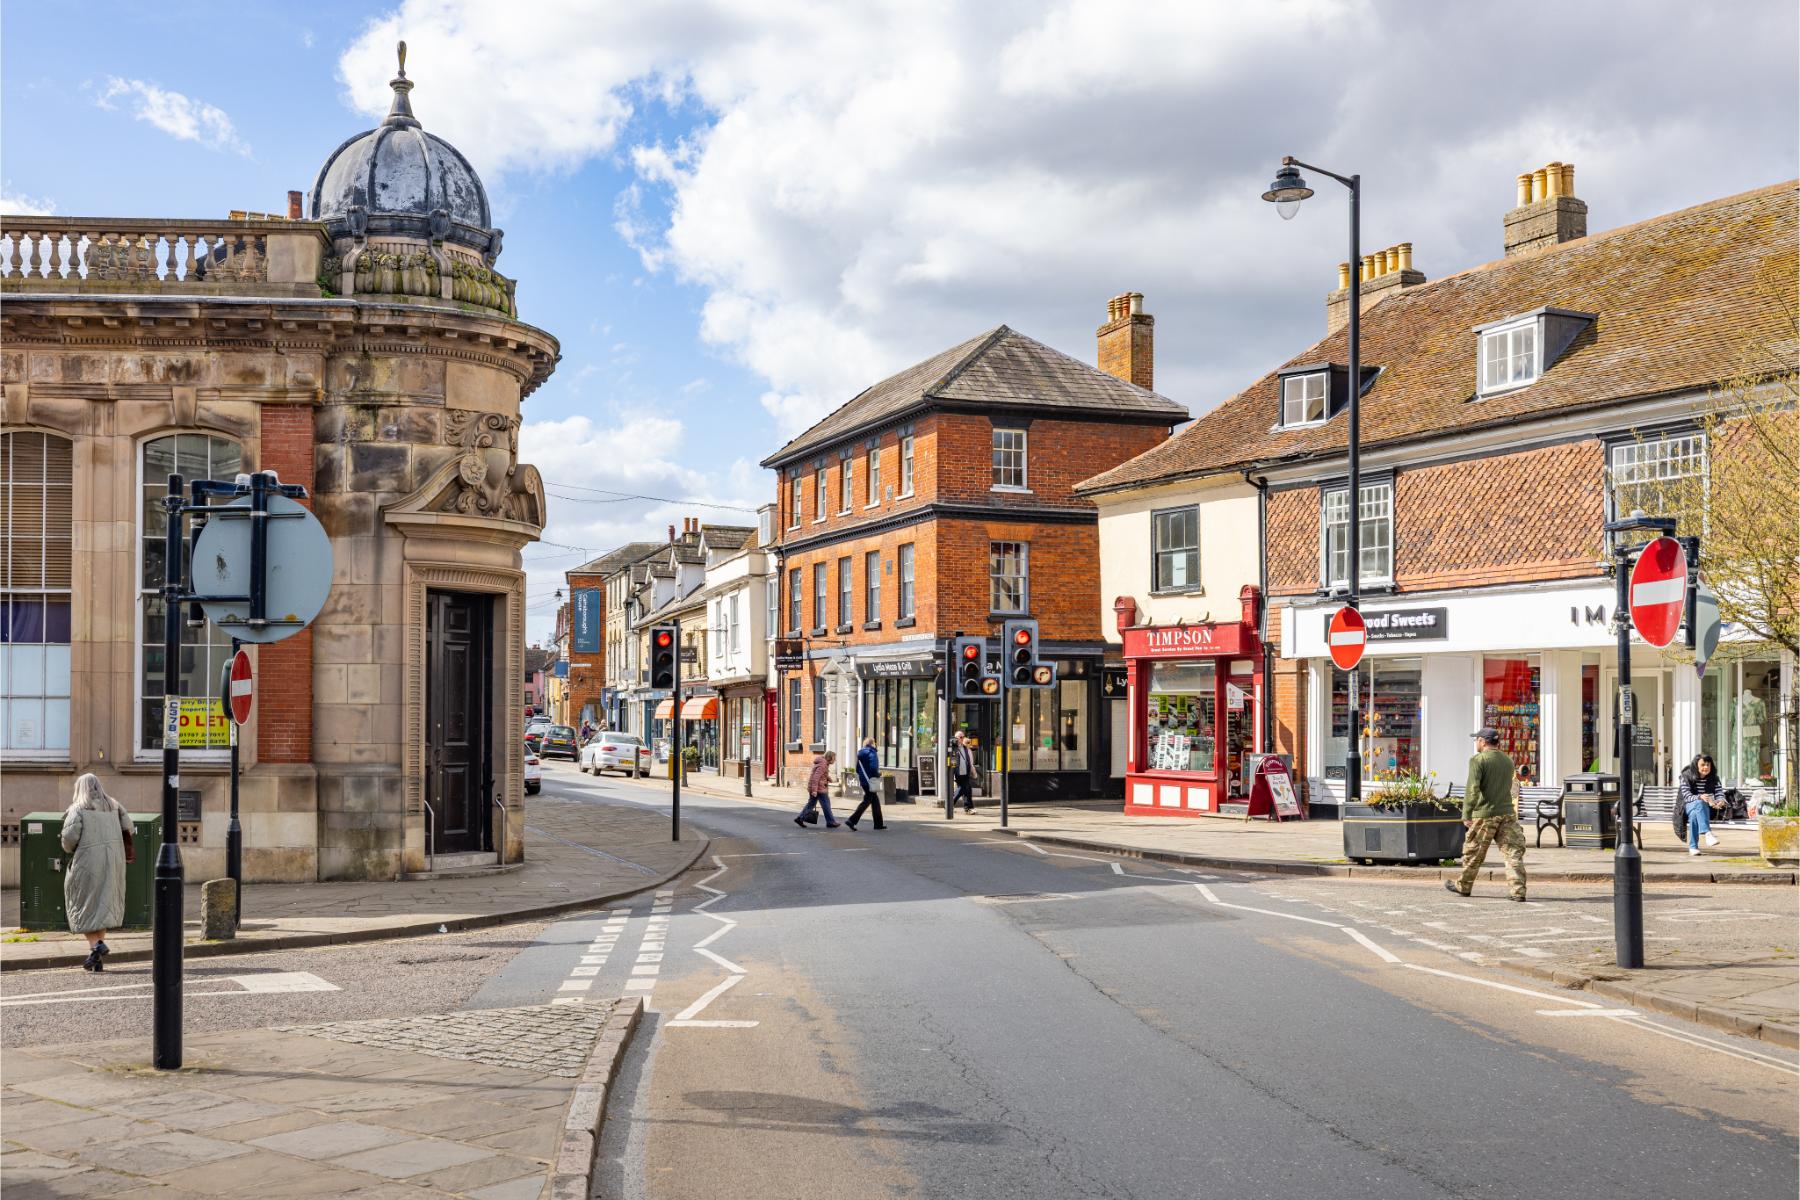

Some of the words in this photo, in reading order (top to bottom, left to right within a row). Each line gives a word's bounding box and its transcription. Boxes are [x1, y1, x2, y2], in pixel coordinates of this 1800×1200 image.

[1391, 612, 1436, 628] Sweets
[1146, 629, 1212, 647] TIMPSON
[195, 715, 225, 727] LET
